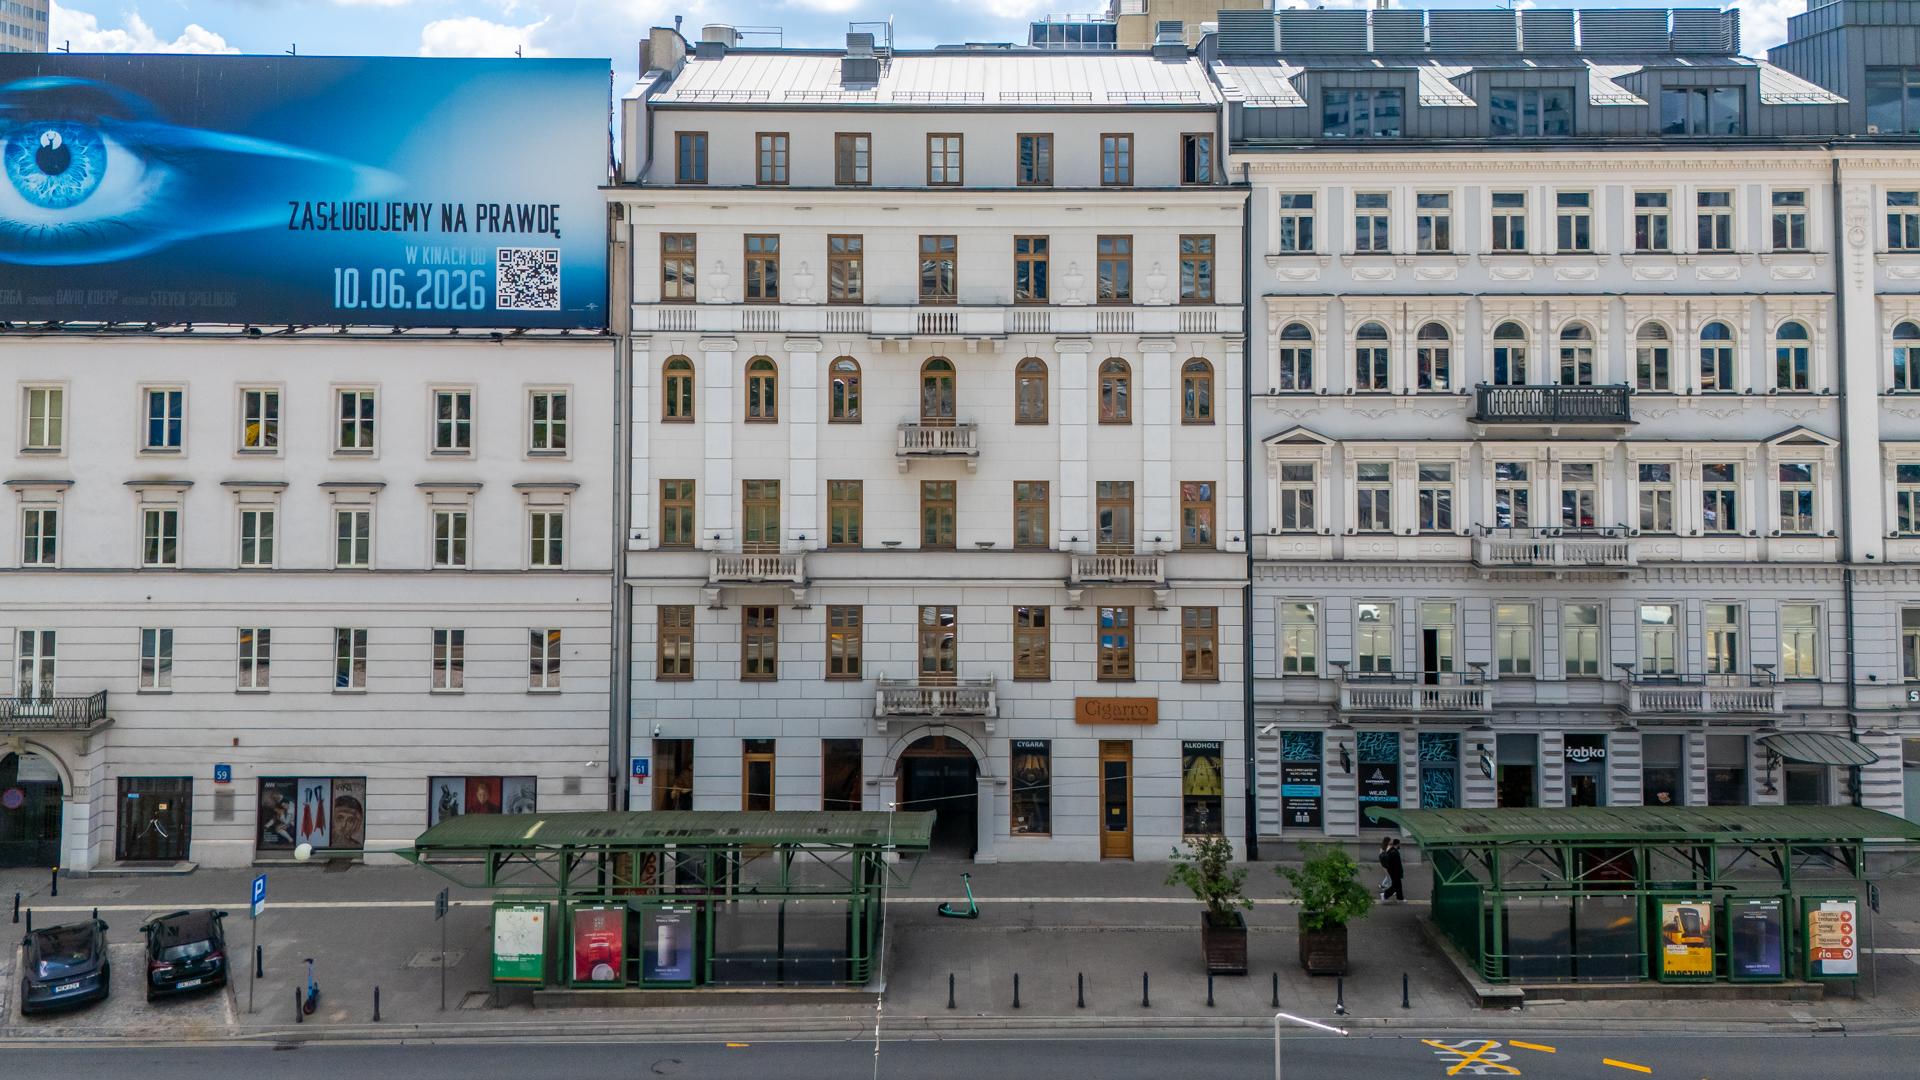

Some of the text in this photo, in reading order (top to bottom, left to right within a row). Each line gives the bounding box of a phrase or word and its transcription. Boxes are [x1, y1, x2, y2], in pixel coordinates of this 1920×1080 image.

[288, 201, 561, 239] ZASŁUGUJEMY NA PRAWDĘ
[405, 246, 486, 265] W KINACH OD
[333, 267, 487, 311] 10.06.2026
[1085, 700, 1149, 719] Cigarro
[1565, 746, 1605, 757] żabka
[216, 770, 227, 780] 59
[636, 765, 645, 774] 61
[1818, 949, 1832, 958] ria
